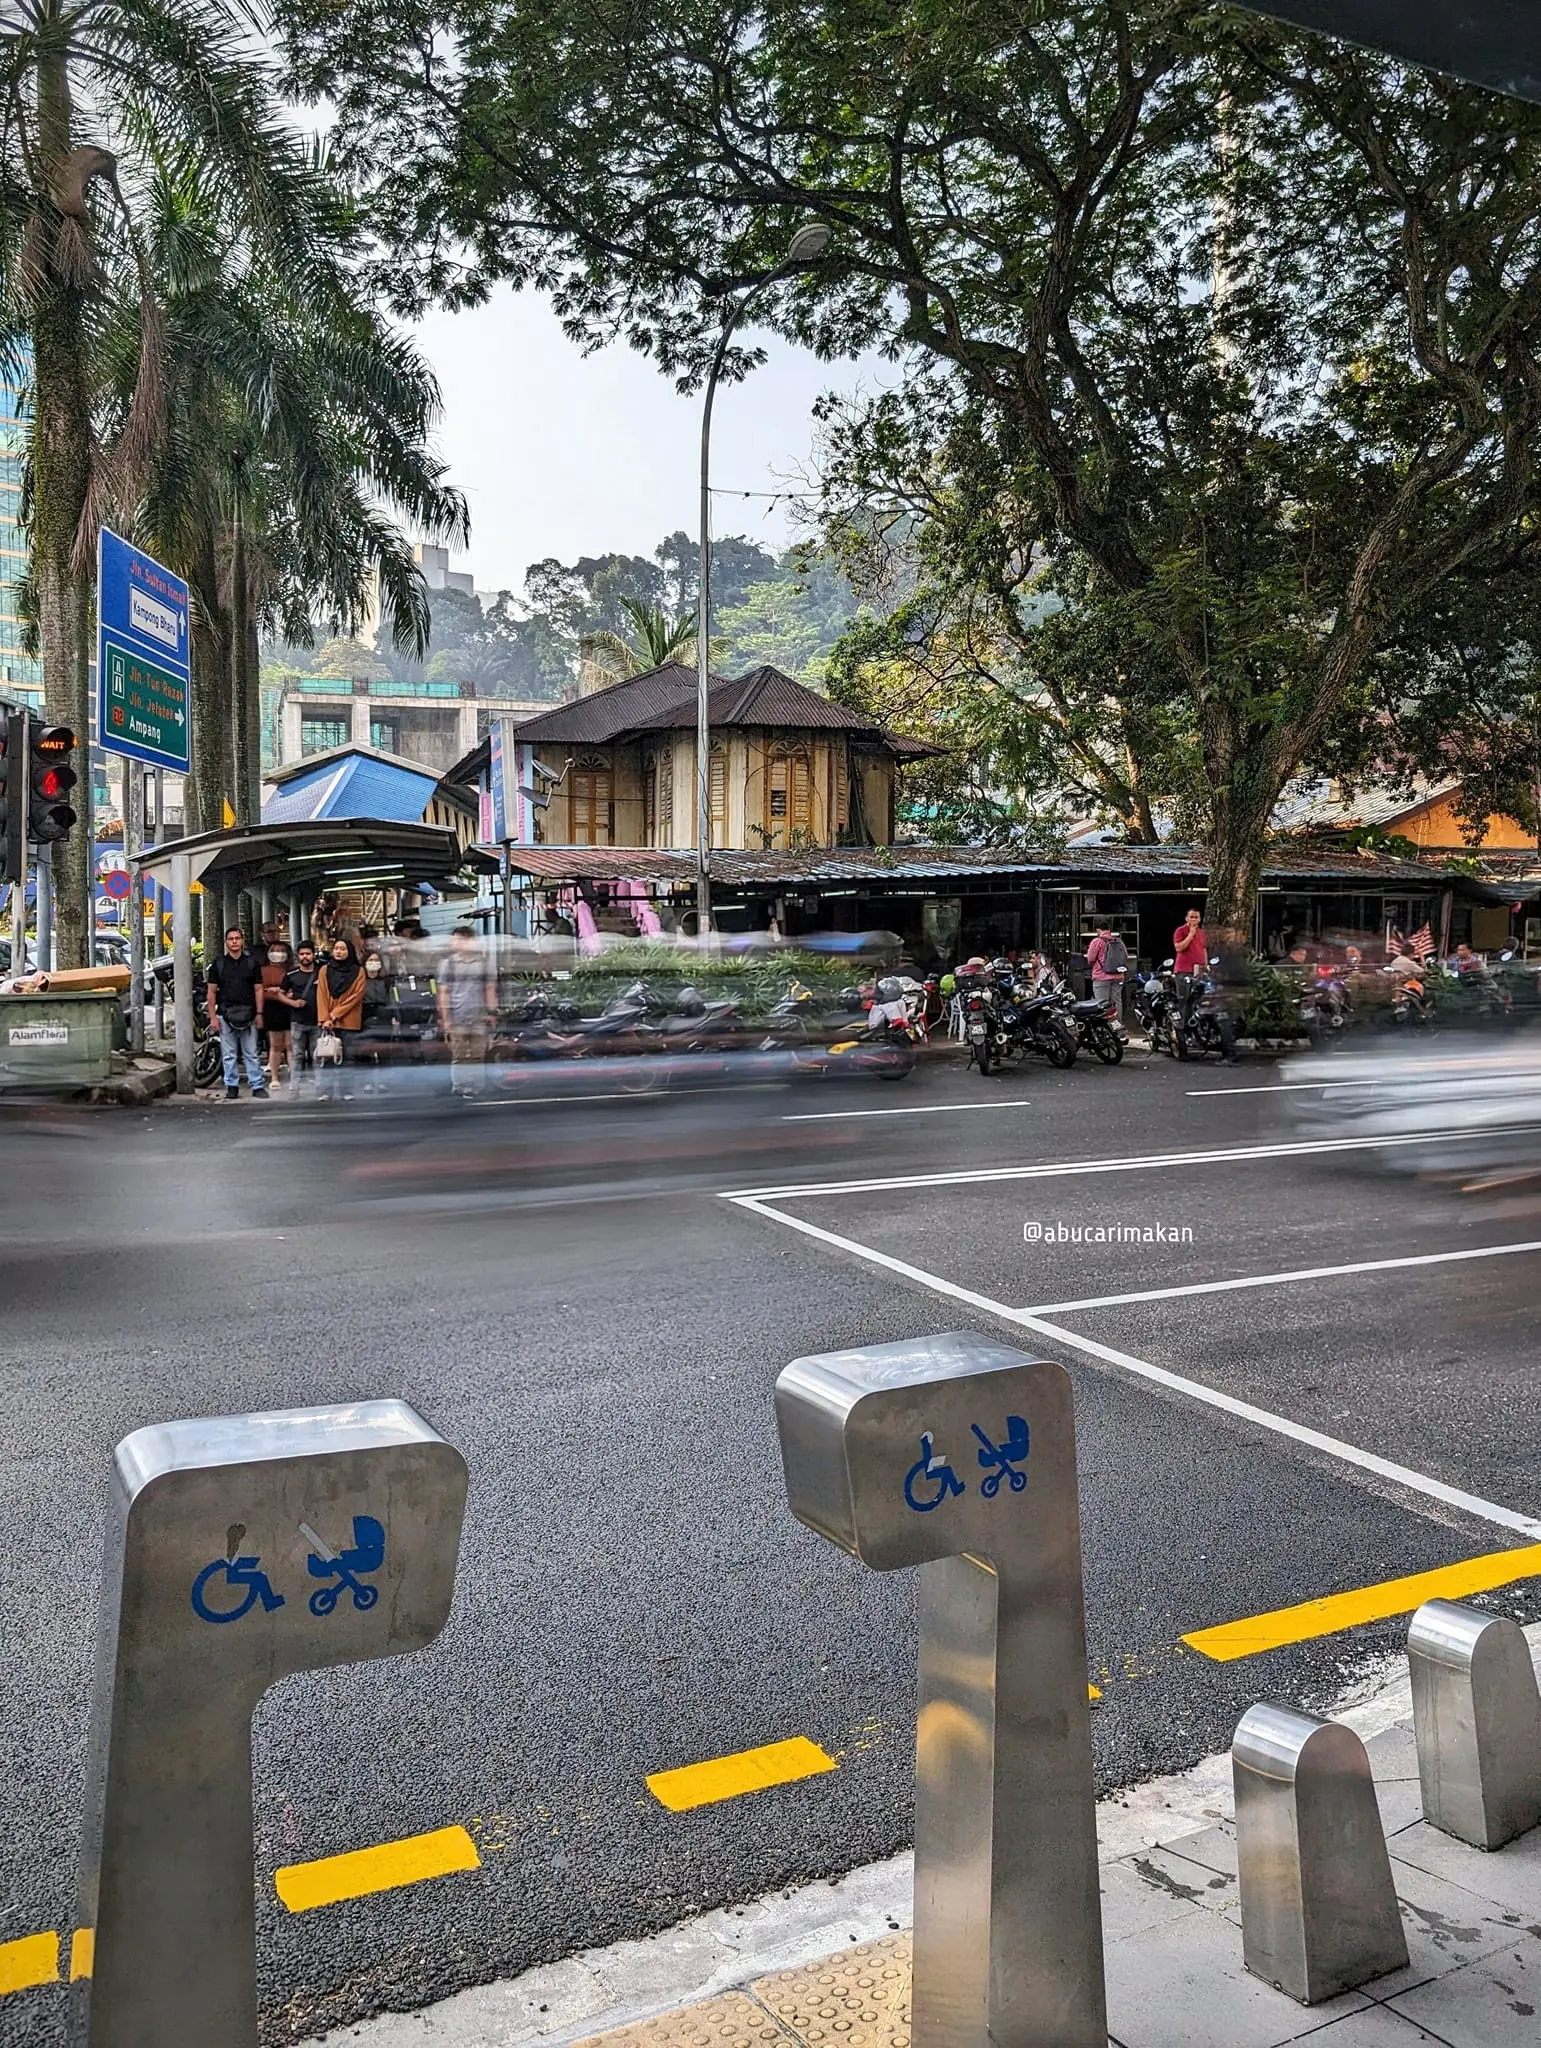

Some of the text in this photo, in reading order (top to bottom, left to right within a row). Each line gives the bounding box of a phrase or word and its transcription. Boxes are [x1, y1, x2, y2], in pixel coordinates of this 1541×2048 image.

[133, 599, 160, 629] Kampong
[146, 672, 160, 691] Tun
[129, 715, 161, 744] Ampang
[40, 741, 65, 749] WAIT
